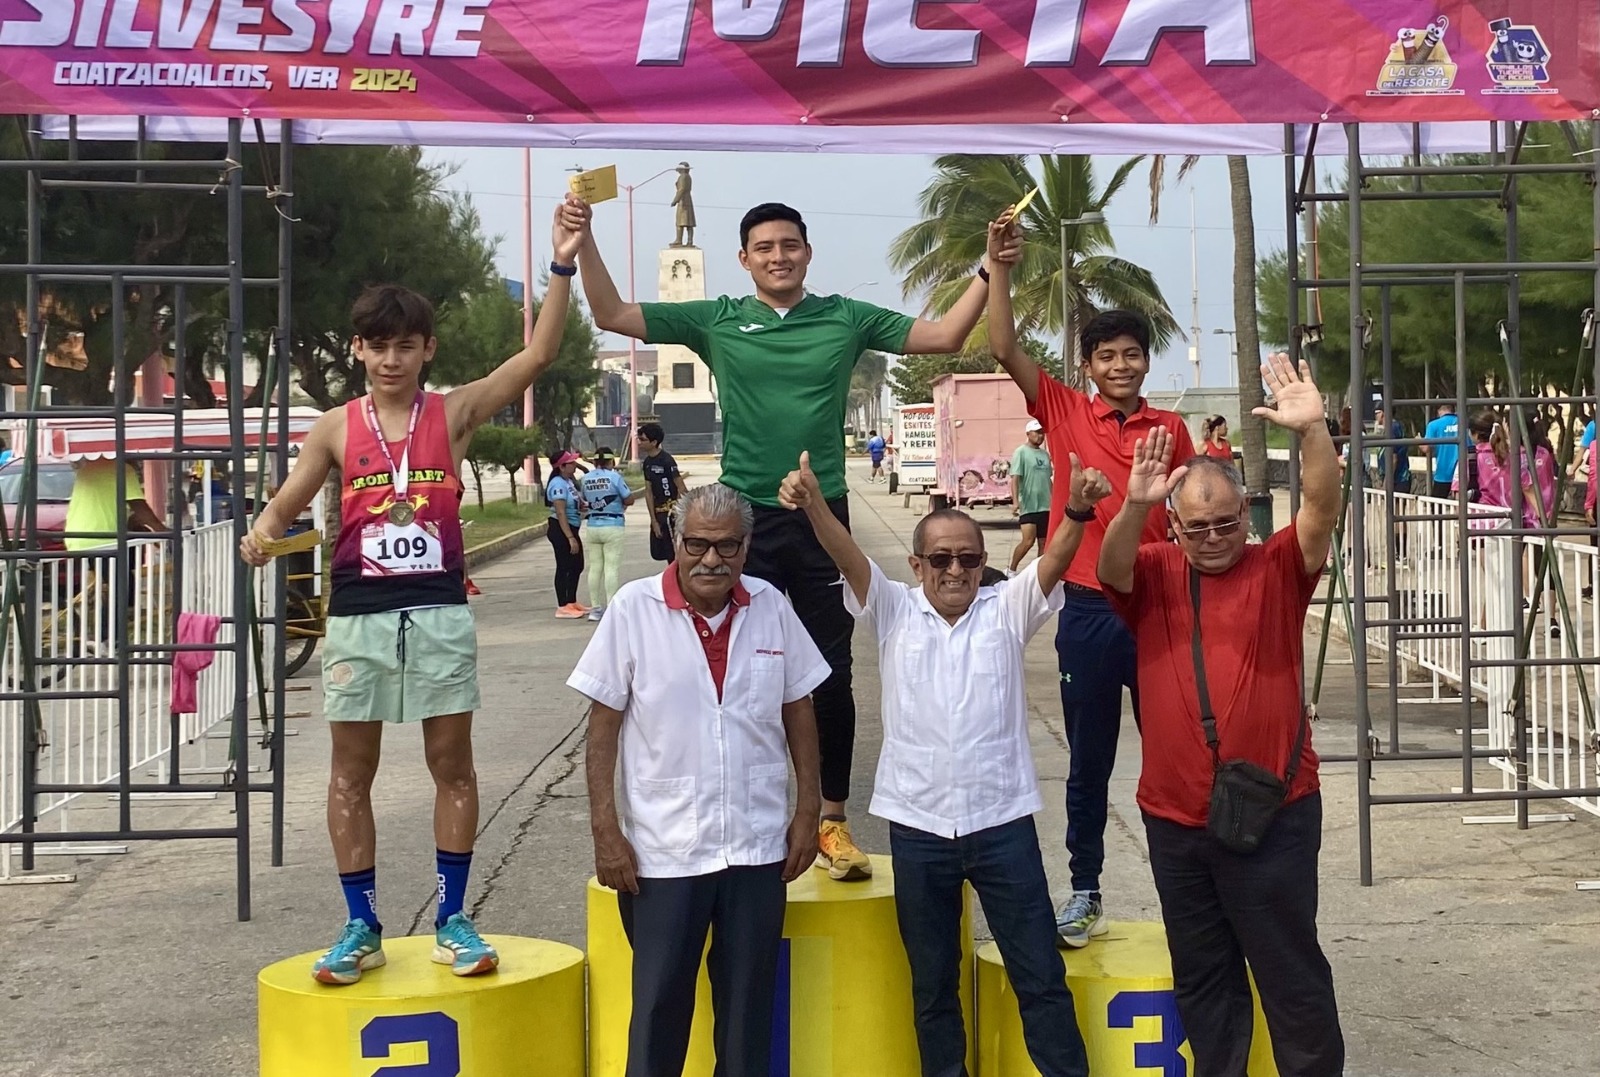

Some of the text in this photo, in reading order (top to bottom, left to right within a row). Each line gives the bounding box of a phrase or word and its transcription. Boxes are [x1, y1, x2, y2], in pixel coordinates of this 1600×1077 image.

[53, 61, 418, 92] COATZACOALCOS, VER 2024
[1389, 66, 1445, 77] LA CASA
[1395, 78, 1449, 87] RESORTE
[352, 469, 445, 489] IRON EART
[377, 536, 428, 561] 109
[360, 1011, 460, 1077] 2
[1107, 990, 1187, 1077] 3
